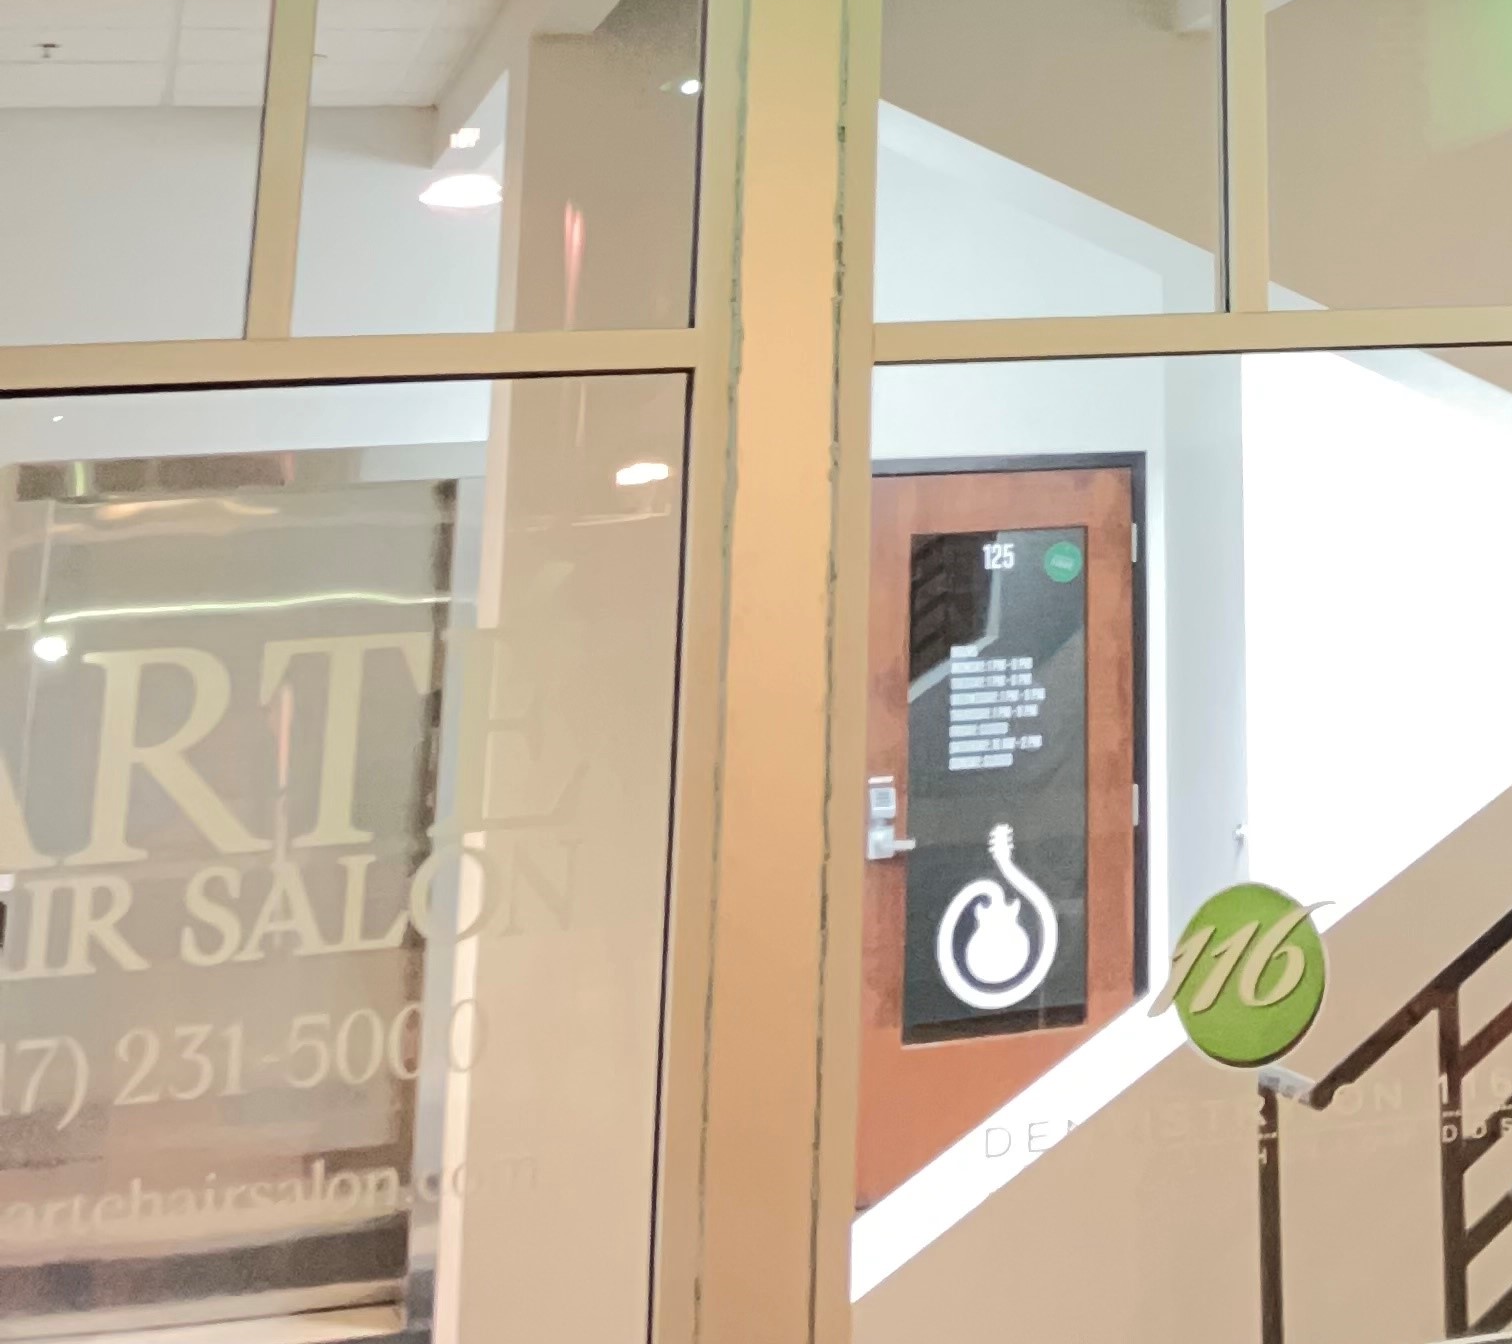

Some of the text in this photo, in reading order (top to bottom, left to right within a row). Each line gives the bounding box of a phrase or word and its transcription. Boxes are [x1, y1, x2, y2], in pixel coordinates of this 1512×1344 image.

[982, 543, 1015, 570] 125
[0, 838, 584, 982] IR SALON
[1147, 900, 1336, 1018] 116
